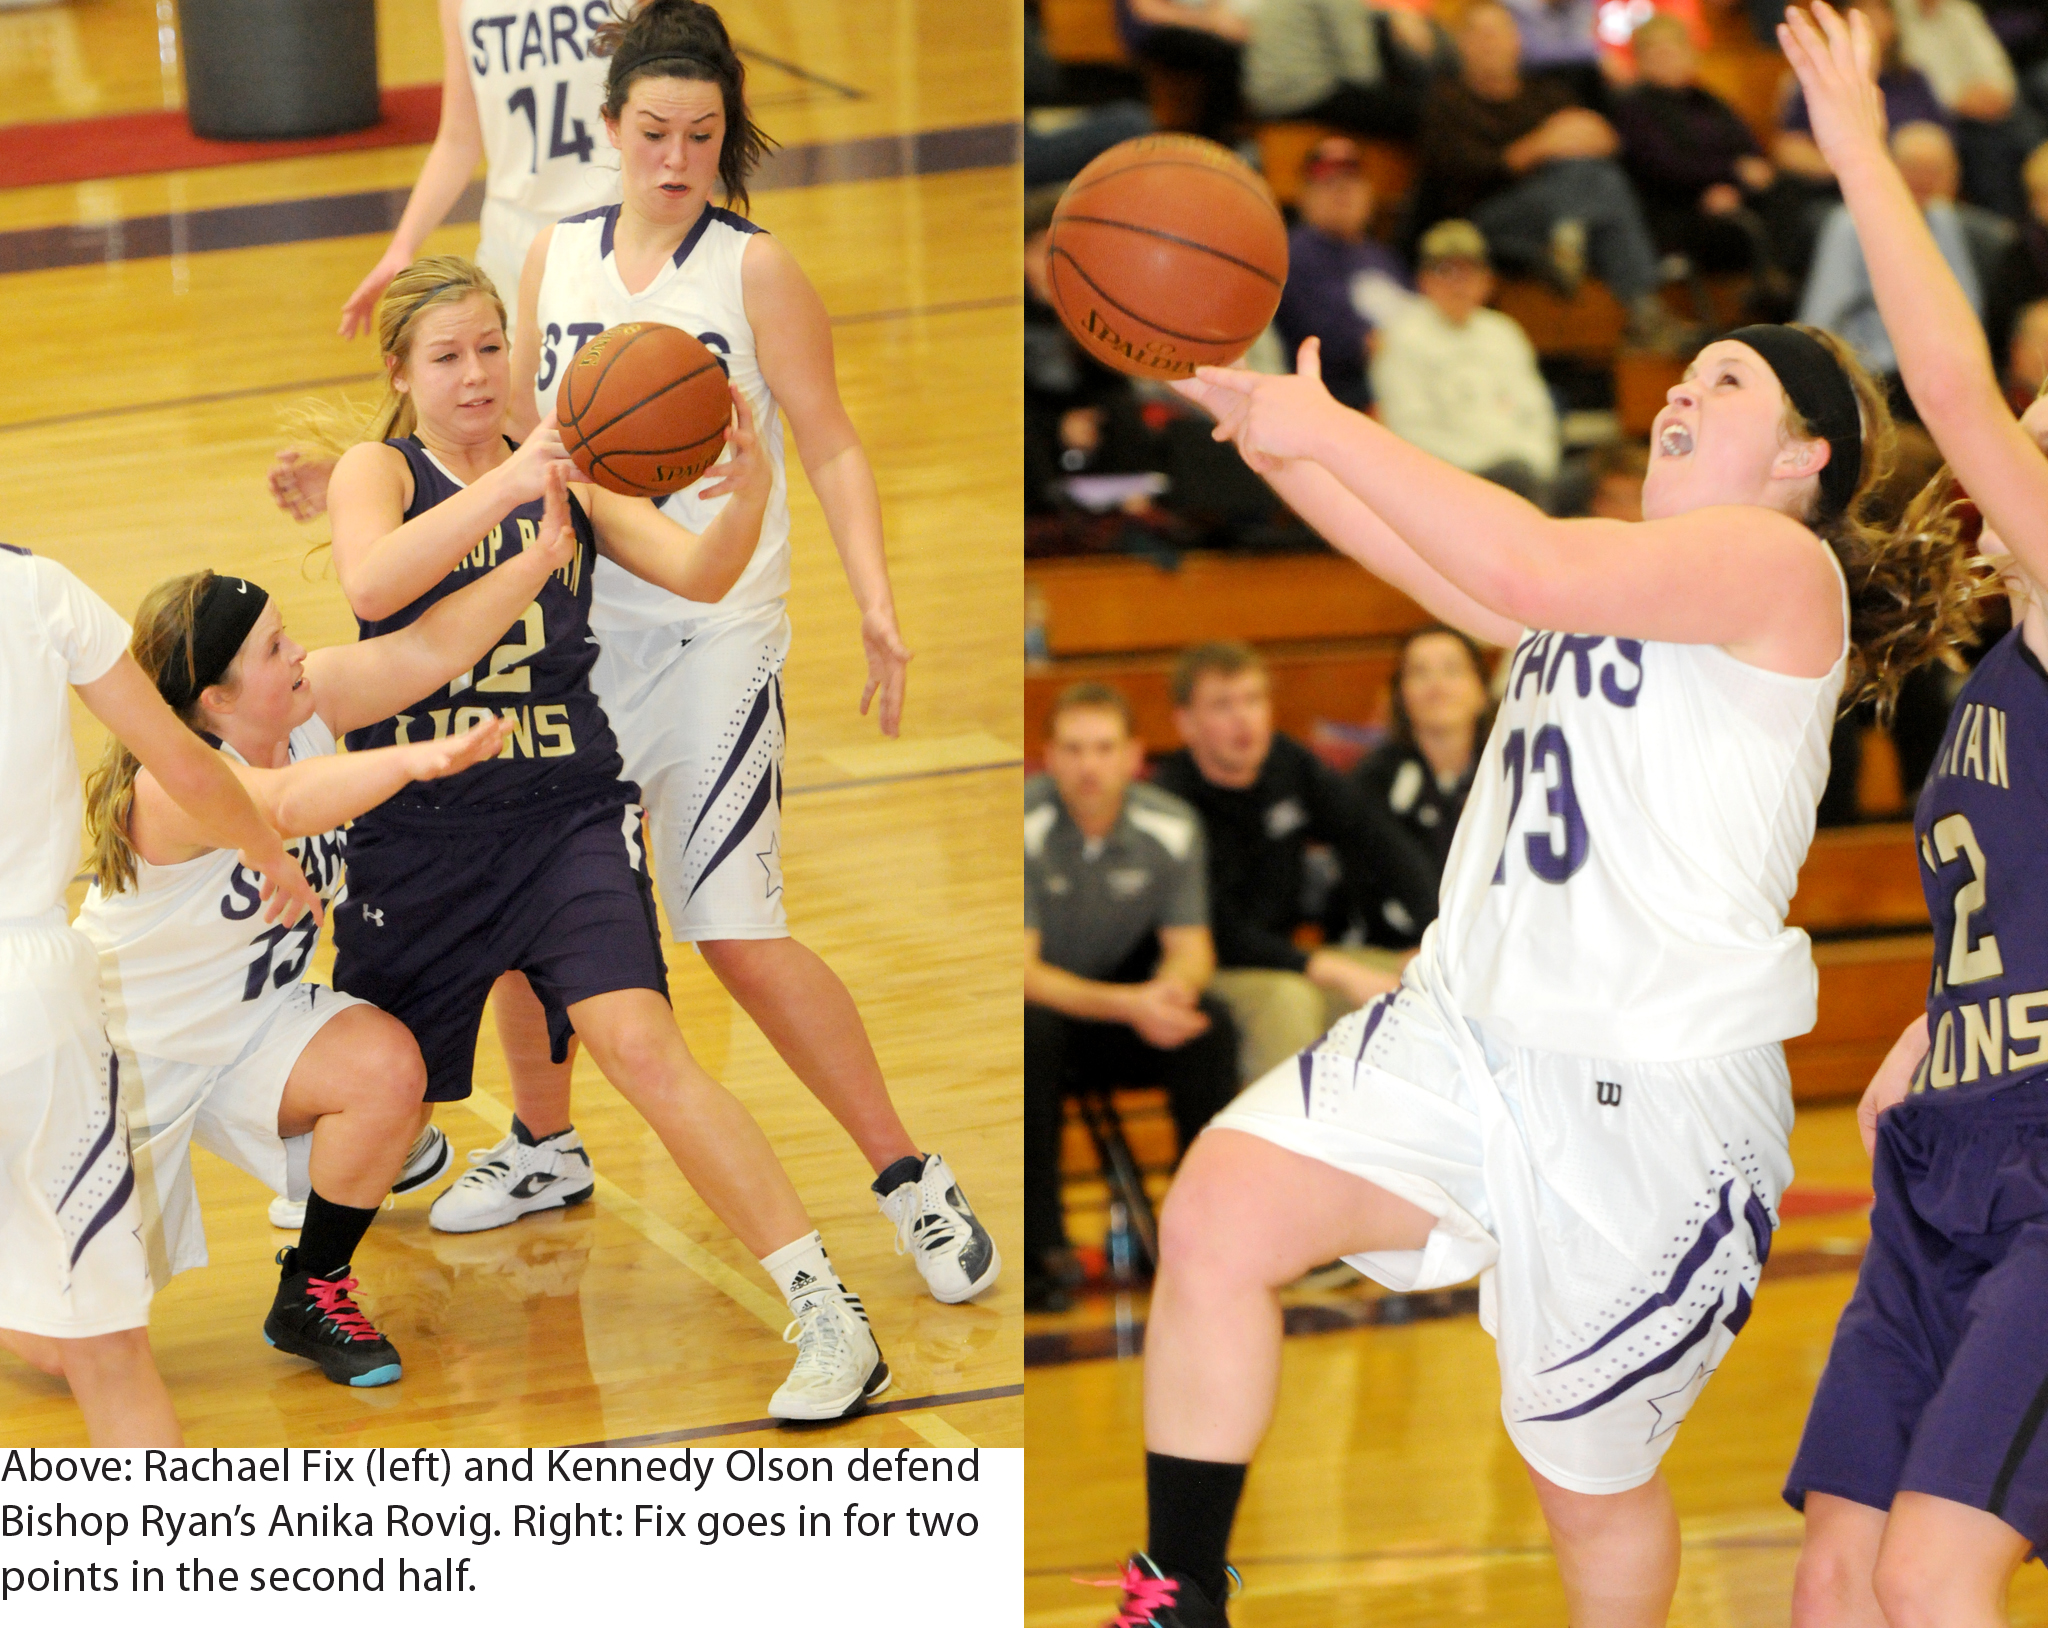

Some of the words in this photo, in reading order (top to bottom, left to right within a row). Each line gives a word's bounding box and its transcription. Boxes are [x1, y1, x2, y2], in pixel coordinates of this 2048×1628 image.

[508, 81, 594, 174] 14
[1081, 309, 1197, 374] SPALDIN
[450, 601, 546, 698] 2
[1490, 723, 1589, 885] 13
[1922, 813, 2003, 996] 2
